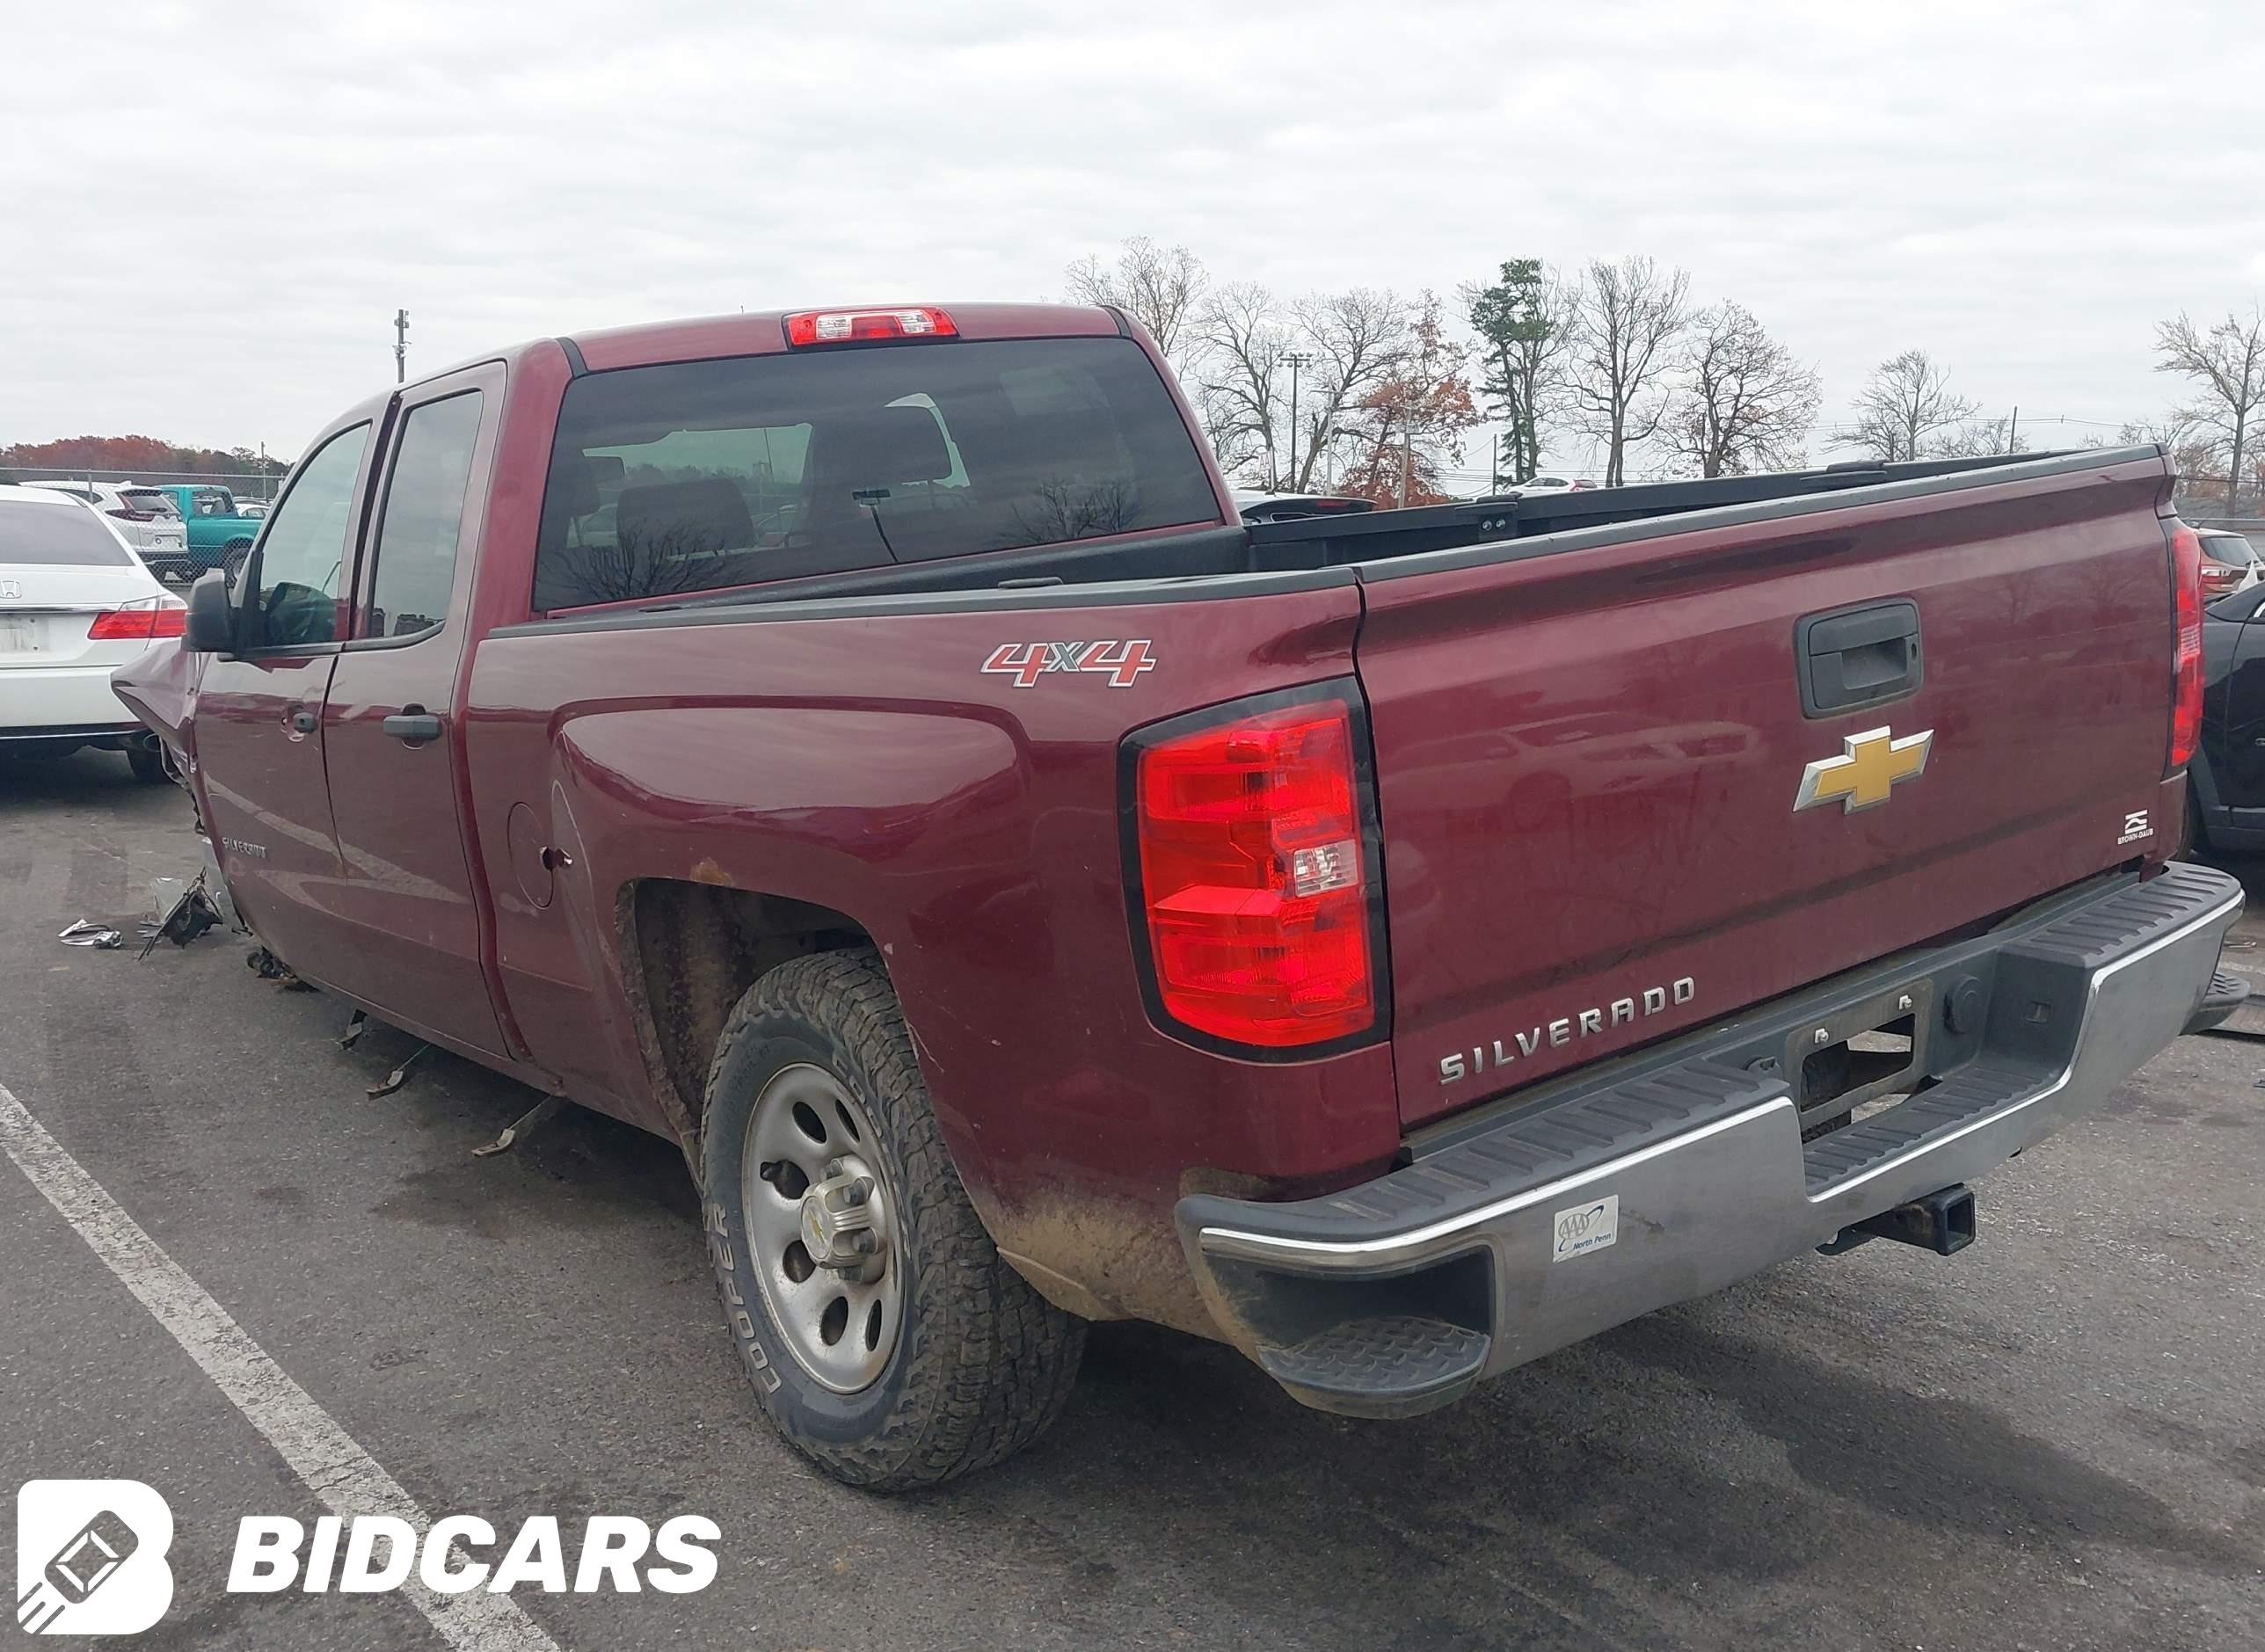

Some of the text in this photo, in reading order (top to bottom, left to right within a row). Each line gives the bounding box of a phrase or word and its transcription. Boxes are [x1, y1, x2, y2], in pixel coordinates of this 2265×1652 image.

[1438, 976, 1695, 1086] SILVERADO
[1560, 1214, 1589, 1239] AAA
[1573, 1233, 1612, 1251] North Penn
[705, 1202, 783, 1394] COOPER
